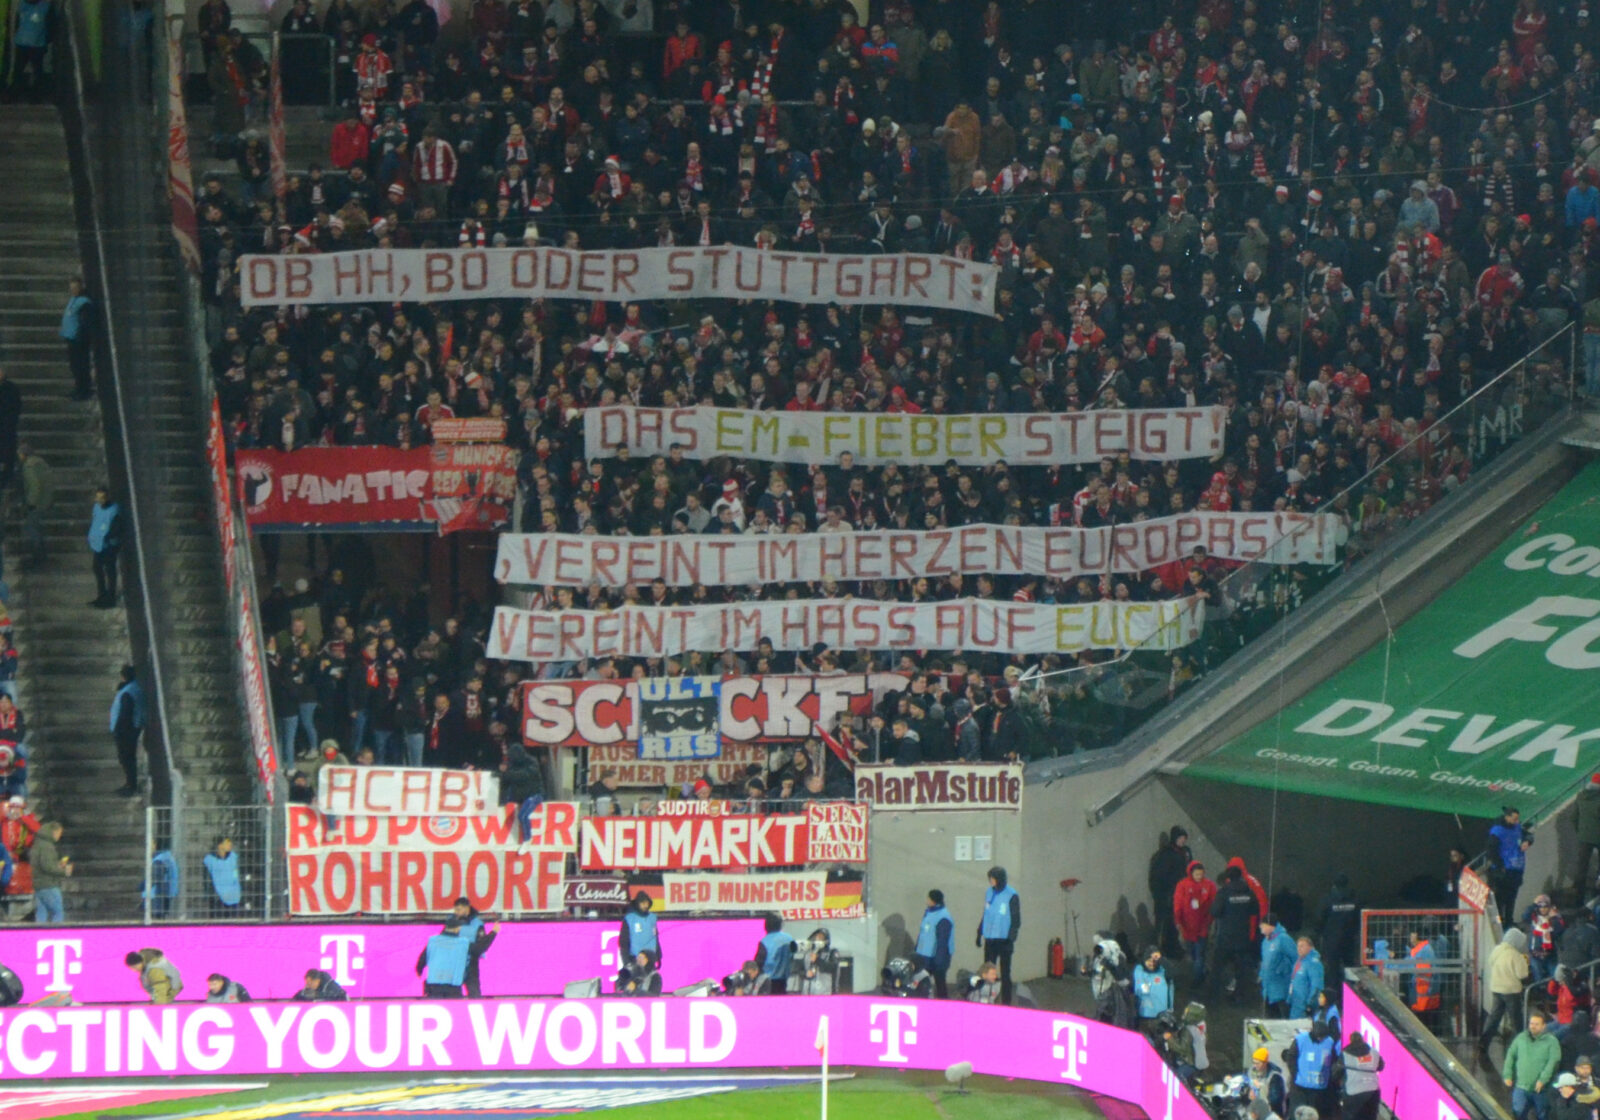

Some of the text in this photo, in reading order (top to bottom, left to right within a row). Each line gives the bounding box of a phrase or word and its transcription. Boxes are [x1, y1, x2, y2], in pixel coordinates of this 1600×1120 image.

[250, 257, 313, 298] OB
[511, 249, 639, 293] ODER
[667, 249, 984, 300] STUTTGART:
[601, 408, 698, 450] DAS
[1025, 411, 1221, 457] STEIGT!
[281, 469, 430, 505] FANATIC
[758, 539, 798, 582] IM
[819, 527, 1022, 578] HERZEN
[1504, 533, 1600, 578] Co
[499, 611, 696, 658] VEREINT
[720, 607, 761, 648] IM
[782, 604, 917, 648] HASS
[936, 604, 1047, 649] AUF
[641, 736, 719, 759] RAS
[1293, 698, 1600, 769] DEVK
[326, 767, 486, 813] ACAB!
[857, 770, 1021, 805] alarMstufe
[1348, 760, 1419, 780] Getan.
[581, 816, 807, 867] NEUMARKT
[811, 824, 864, 842] LAND
[811, 843, 863, 859] FRONT
[289, 850, 561, 913] ROHRDORF
[669, 882, 711, 904] RED
[0, 999, 738, 1077] CTING YOUR WORLD
